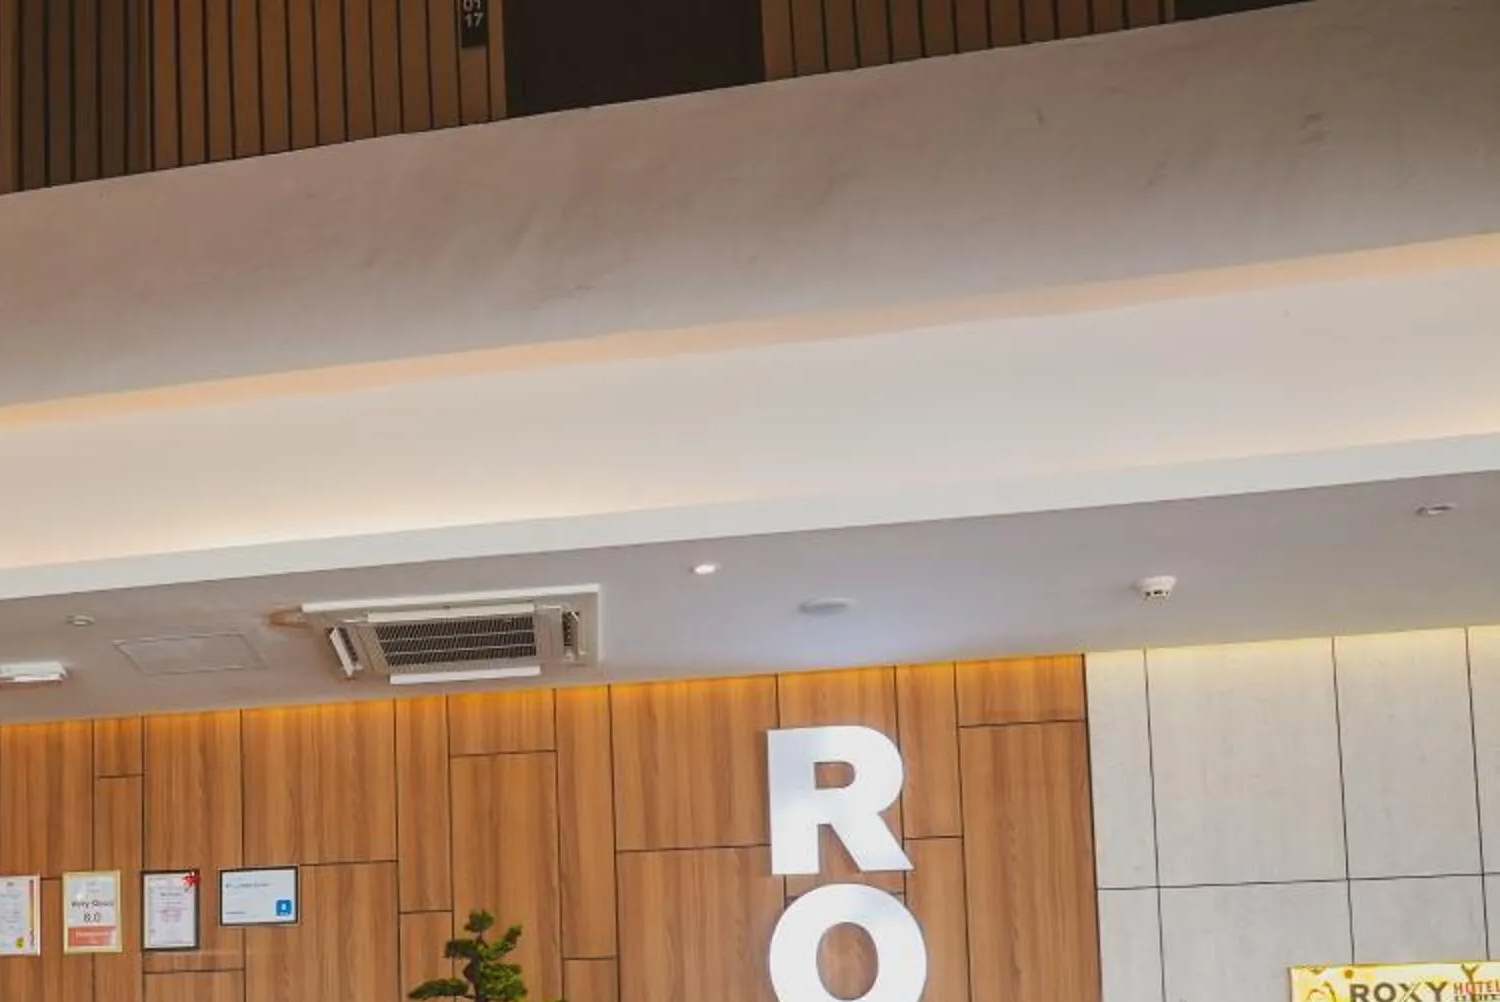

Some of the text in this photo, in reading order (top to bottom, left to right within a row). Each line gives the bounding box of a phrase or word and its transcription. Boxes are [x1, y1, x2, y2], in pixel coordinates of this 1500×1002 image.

[464, 12, 484, 28] 17
[71, 900, 90, 909] Very
[83, 912, 101, 923] 8.0
